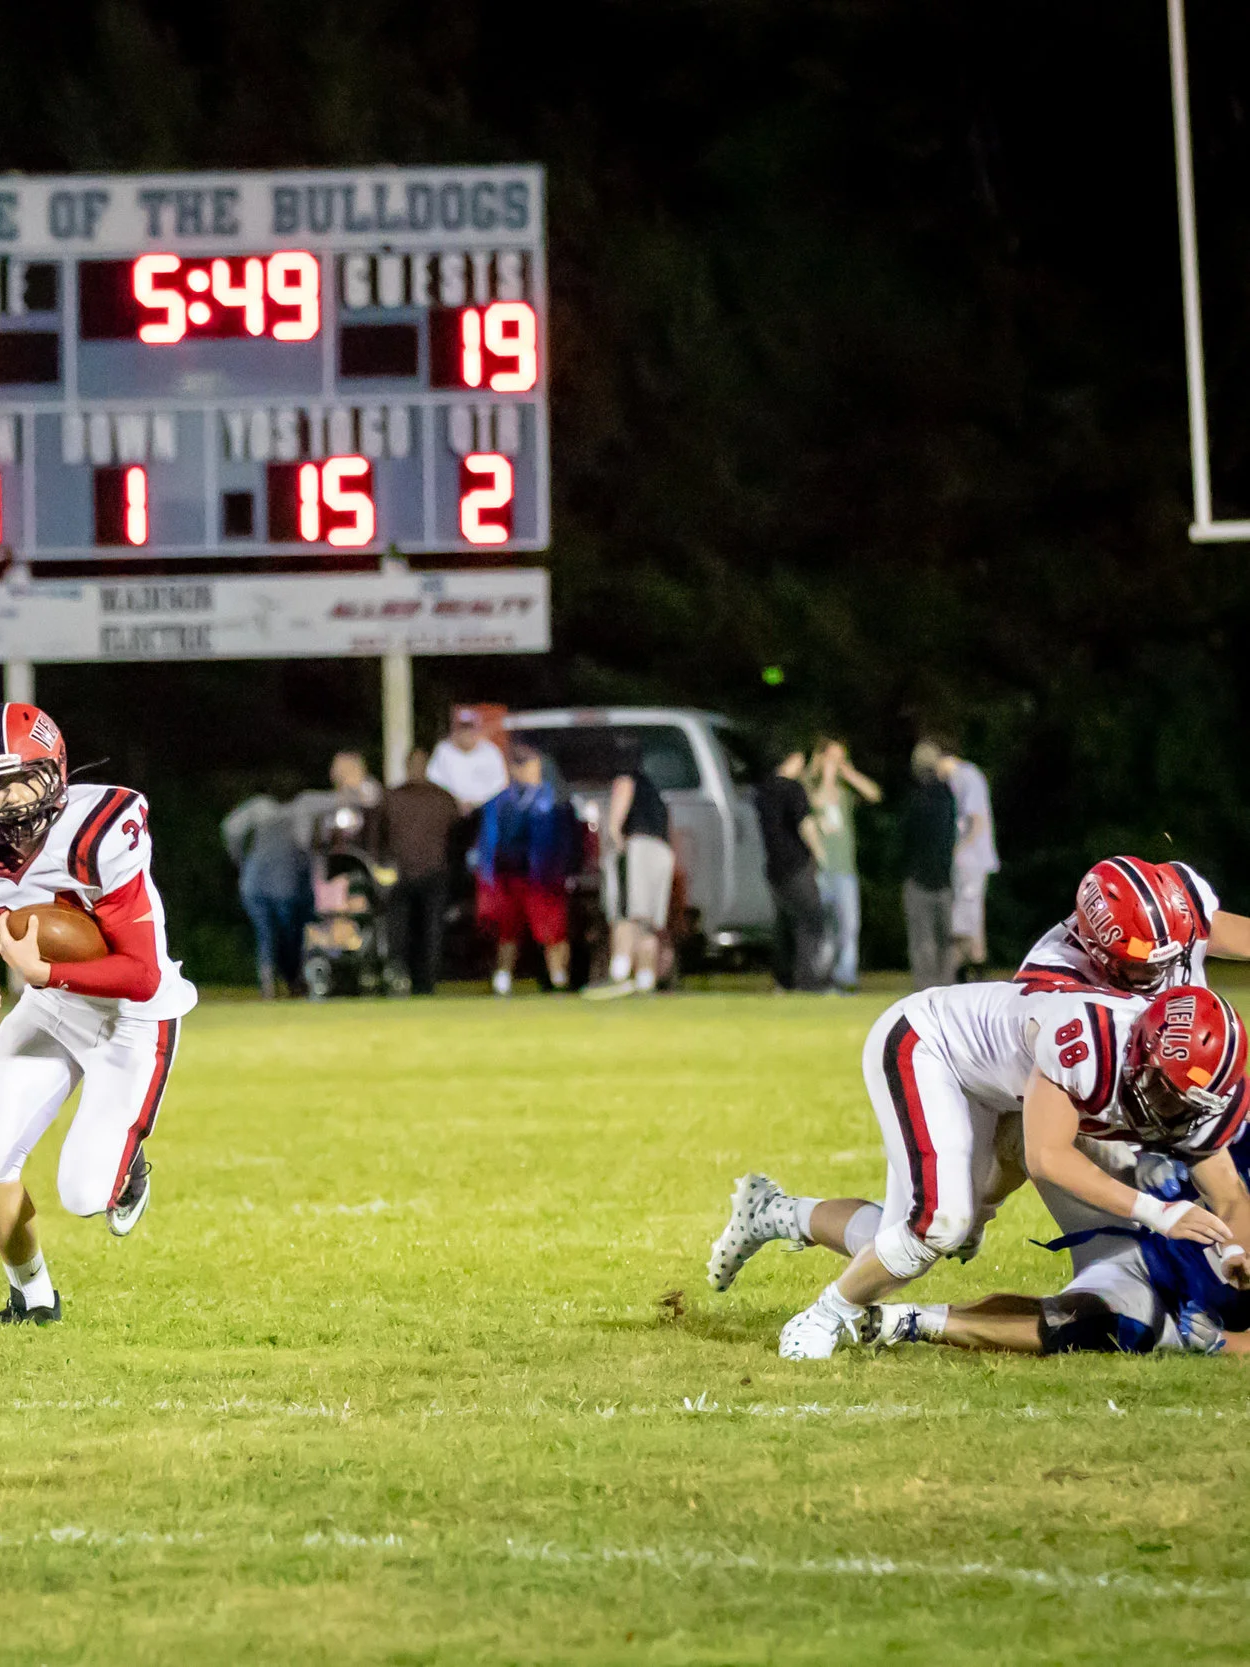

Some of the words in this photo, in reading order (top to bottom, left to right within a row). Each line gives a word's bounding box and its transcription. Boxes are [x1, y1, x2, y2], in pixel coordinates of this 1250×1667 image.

[49, 189, 111, 240] OF
[138, 186, 239, 239] THE
[272, 179, 530, 235] BULLDOGS
[132, 250, 321, 344] 5:49
[459, 300, 537, 393] 19
[123, 465, 149, 546] 1
[299, 454, 375, 547] 15
[460, 452, 514, 545] 2
[1054, 1017, 1090, 1069] 88
[1161, 995, 1197, 1061] WELLS
